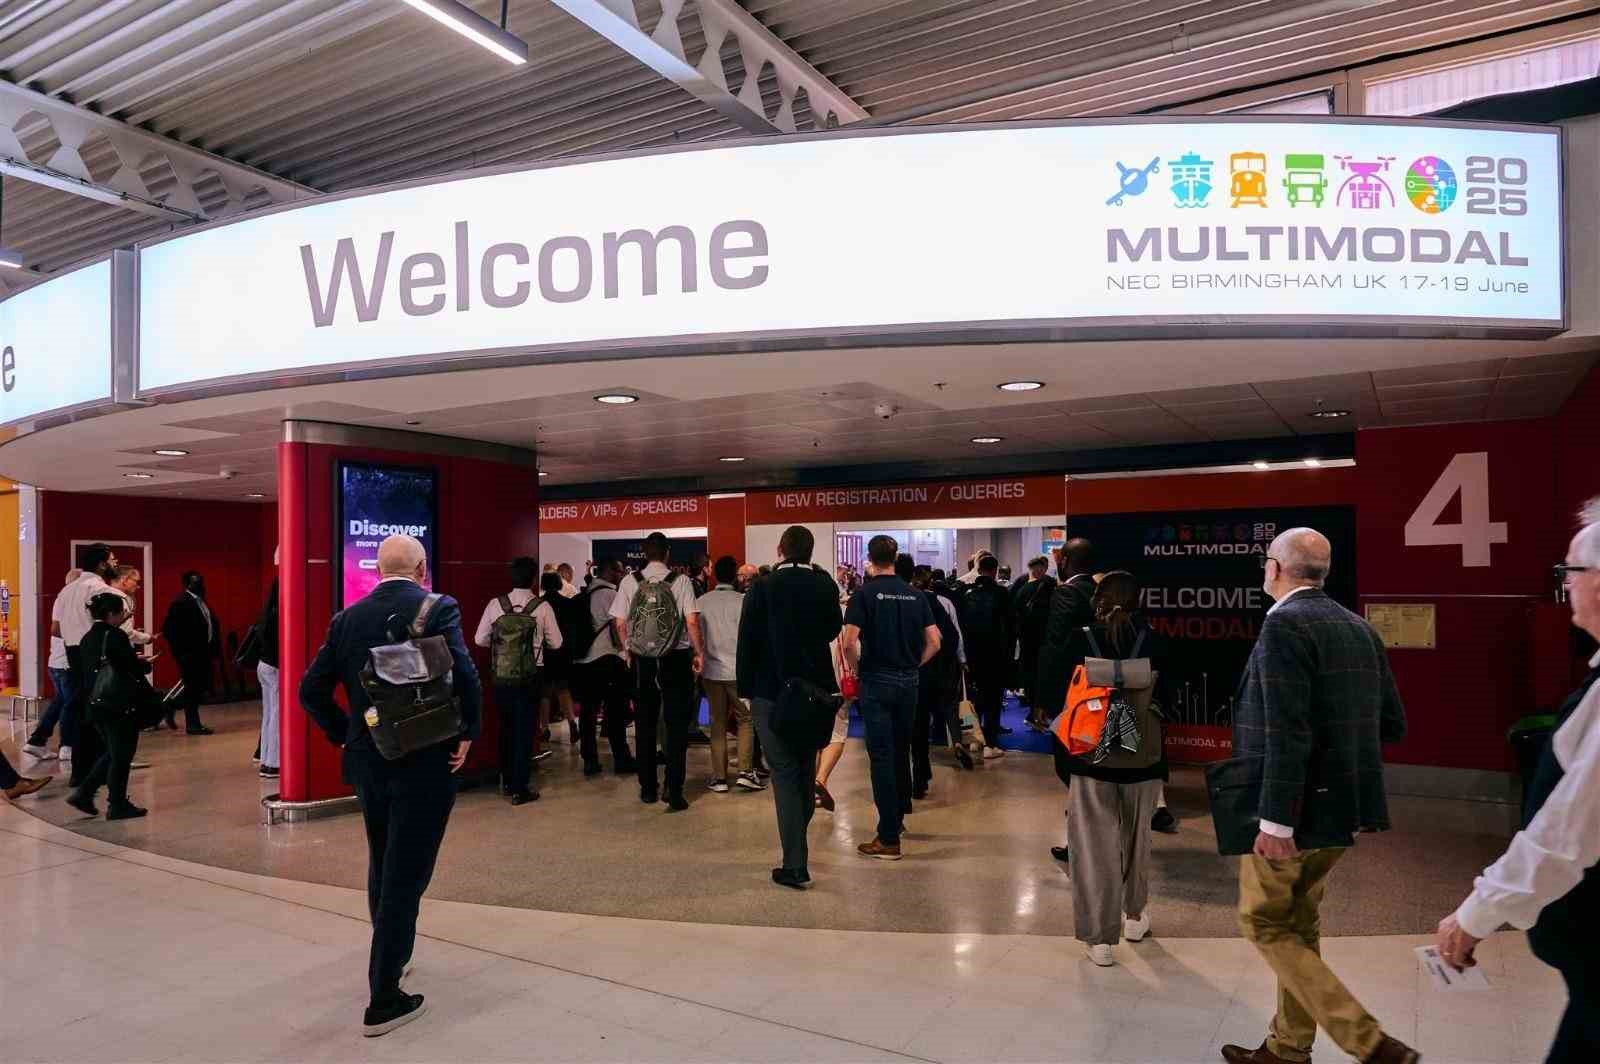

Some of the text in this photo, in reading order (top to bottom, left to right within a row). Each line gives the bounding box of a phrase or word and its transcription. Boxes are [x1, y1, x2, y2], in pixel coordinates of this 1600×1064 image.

[1466, 156, 1528, 185] 20
[1466, 187, 1528, 217] 25
[1107, 225, 1529, 266] MULTIMODAL
[300, 219, 769, 328] Welcome
[1106, 271, 1530, 294] NEC BIRMINGHAM UK 17-19 June
[2, 345, 16, 393] e
[633, 498, 698, 515] SPEAKERS
[775, 481, 1025, 509] NEW REGISTRATION / QUERIES
[1403, 451, 1509, 568] 4
[349, 519, 427, 537] Discover
